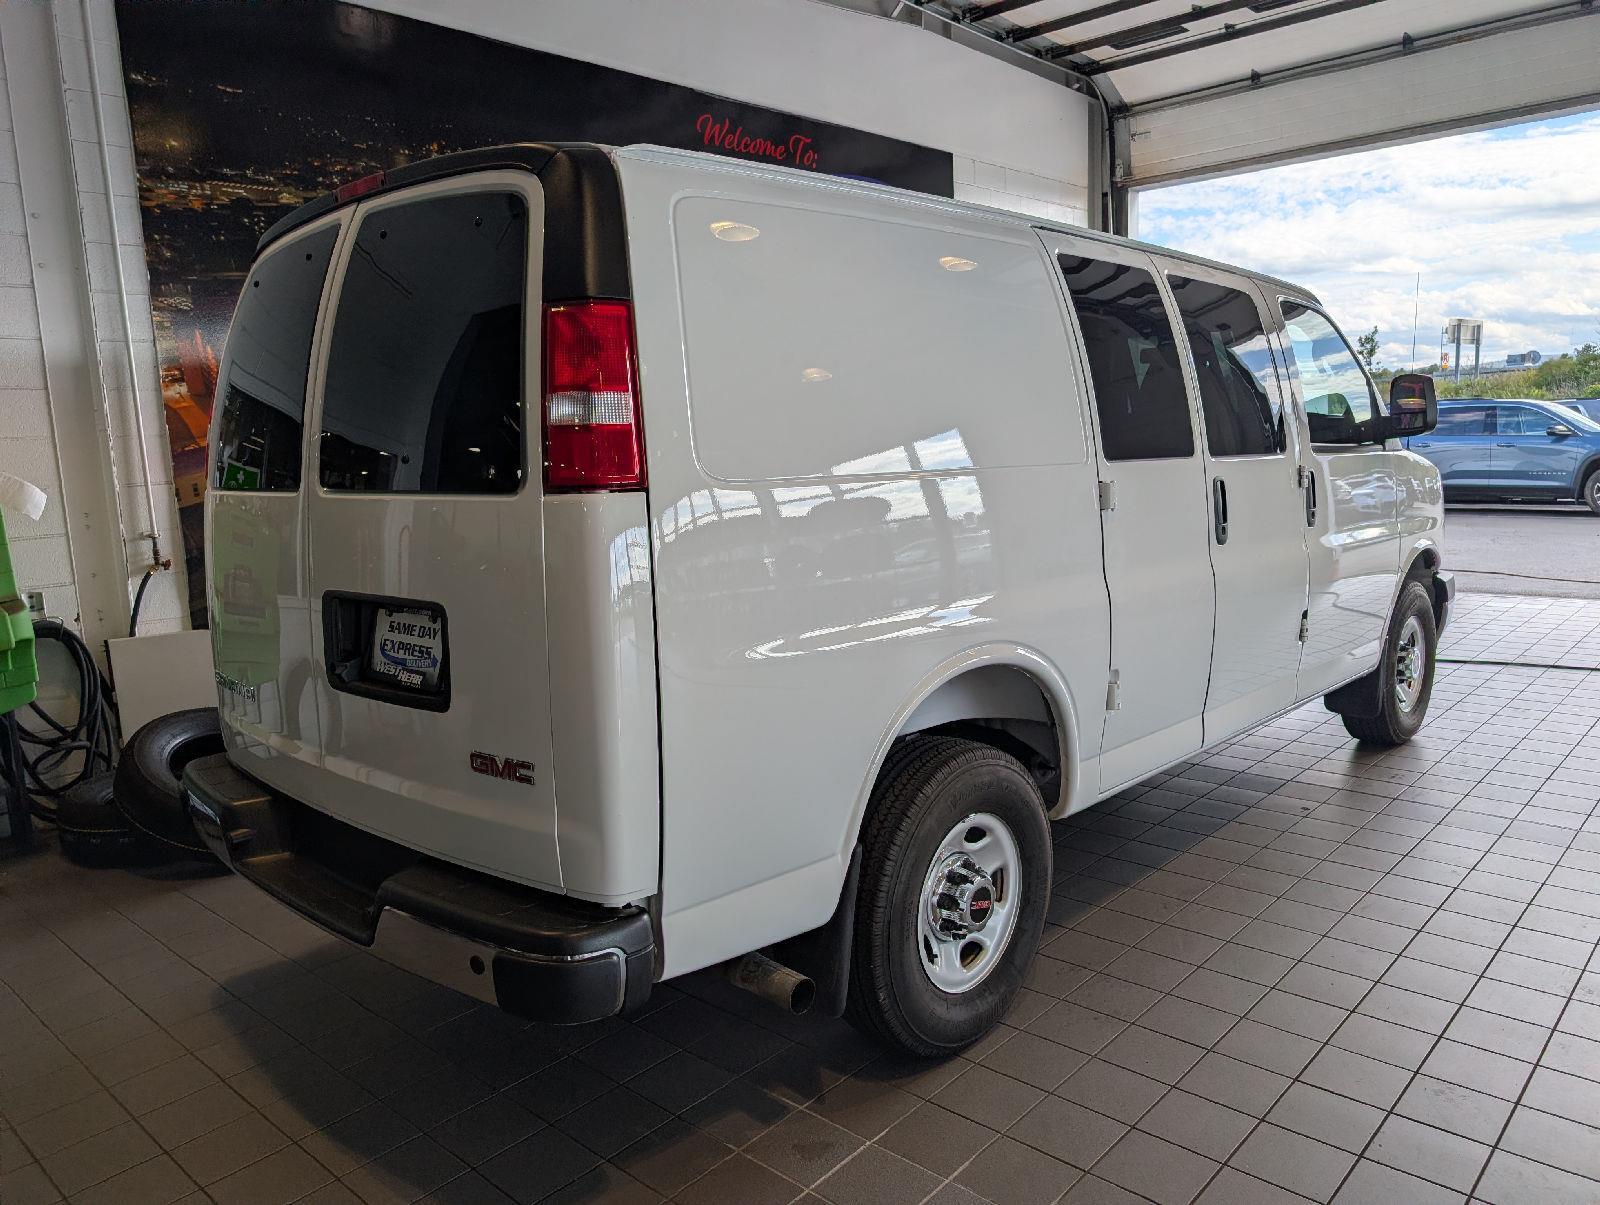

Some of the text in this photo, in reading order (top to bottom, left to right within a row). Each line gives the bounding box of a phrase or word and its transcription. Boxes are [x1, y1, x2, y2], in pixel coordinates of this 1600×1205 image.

[696, 114, 819, 169] Welcome To:
[387, 620, 441, 640] SAME DAY
[382, 638, 434, 660] EXPRESS
[470, 750, 535, 785] GMC
